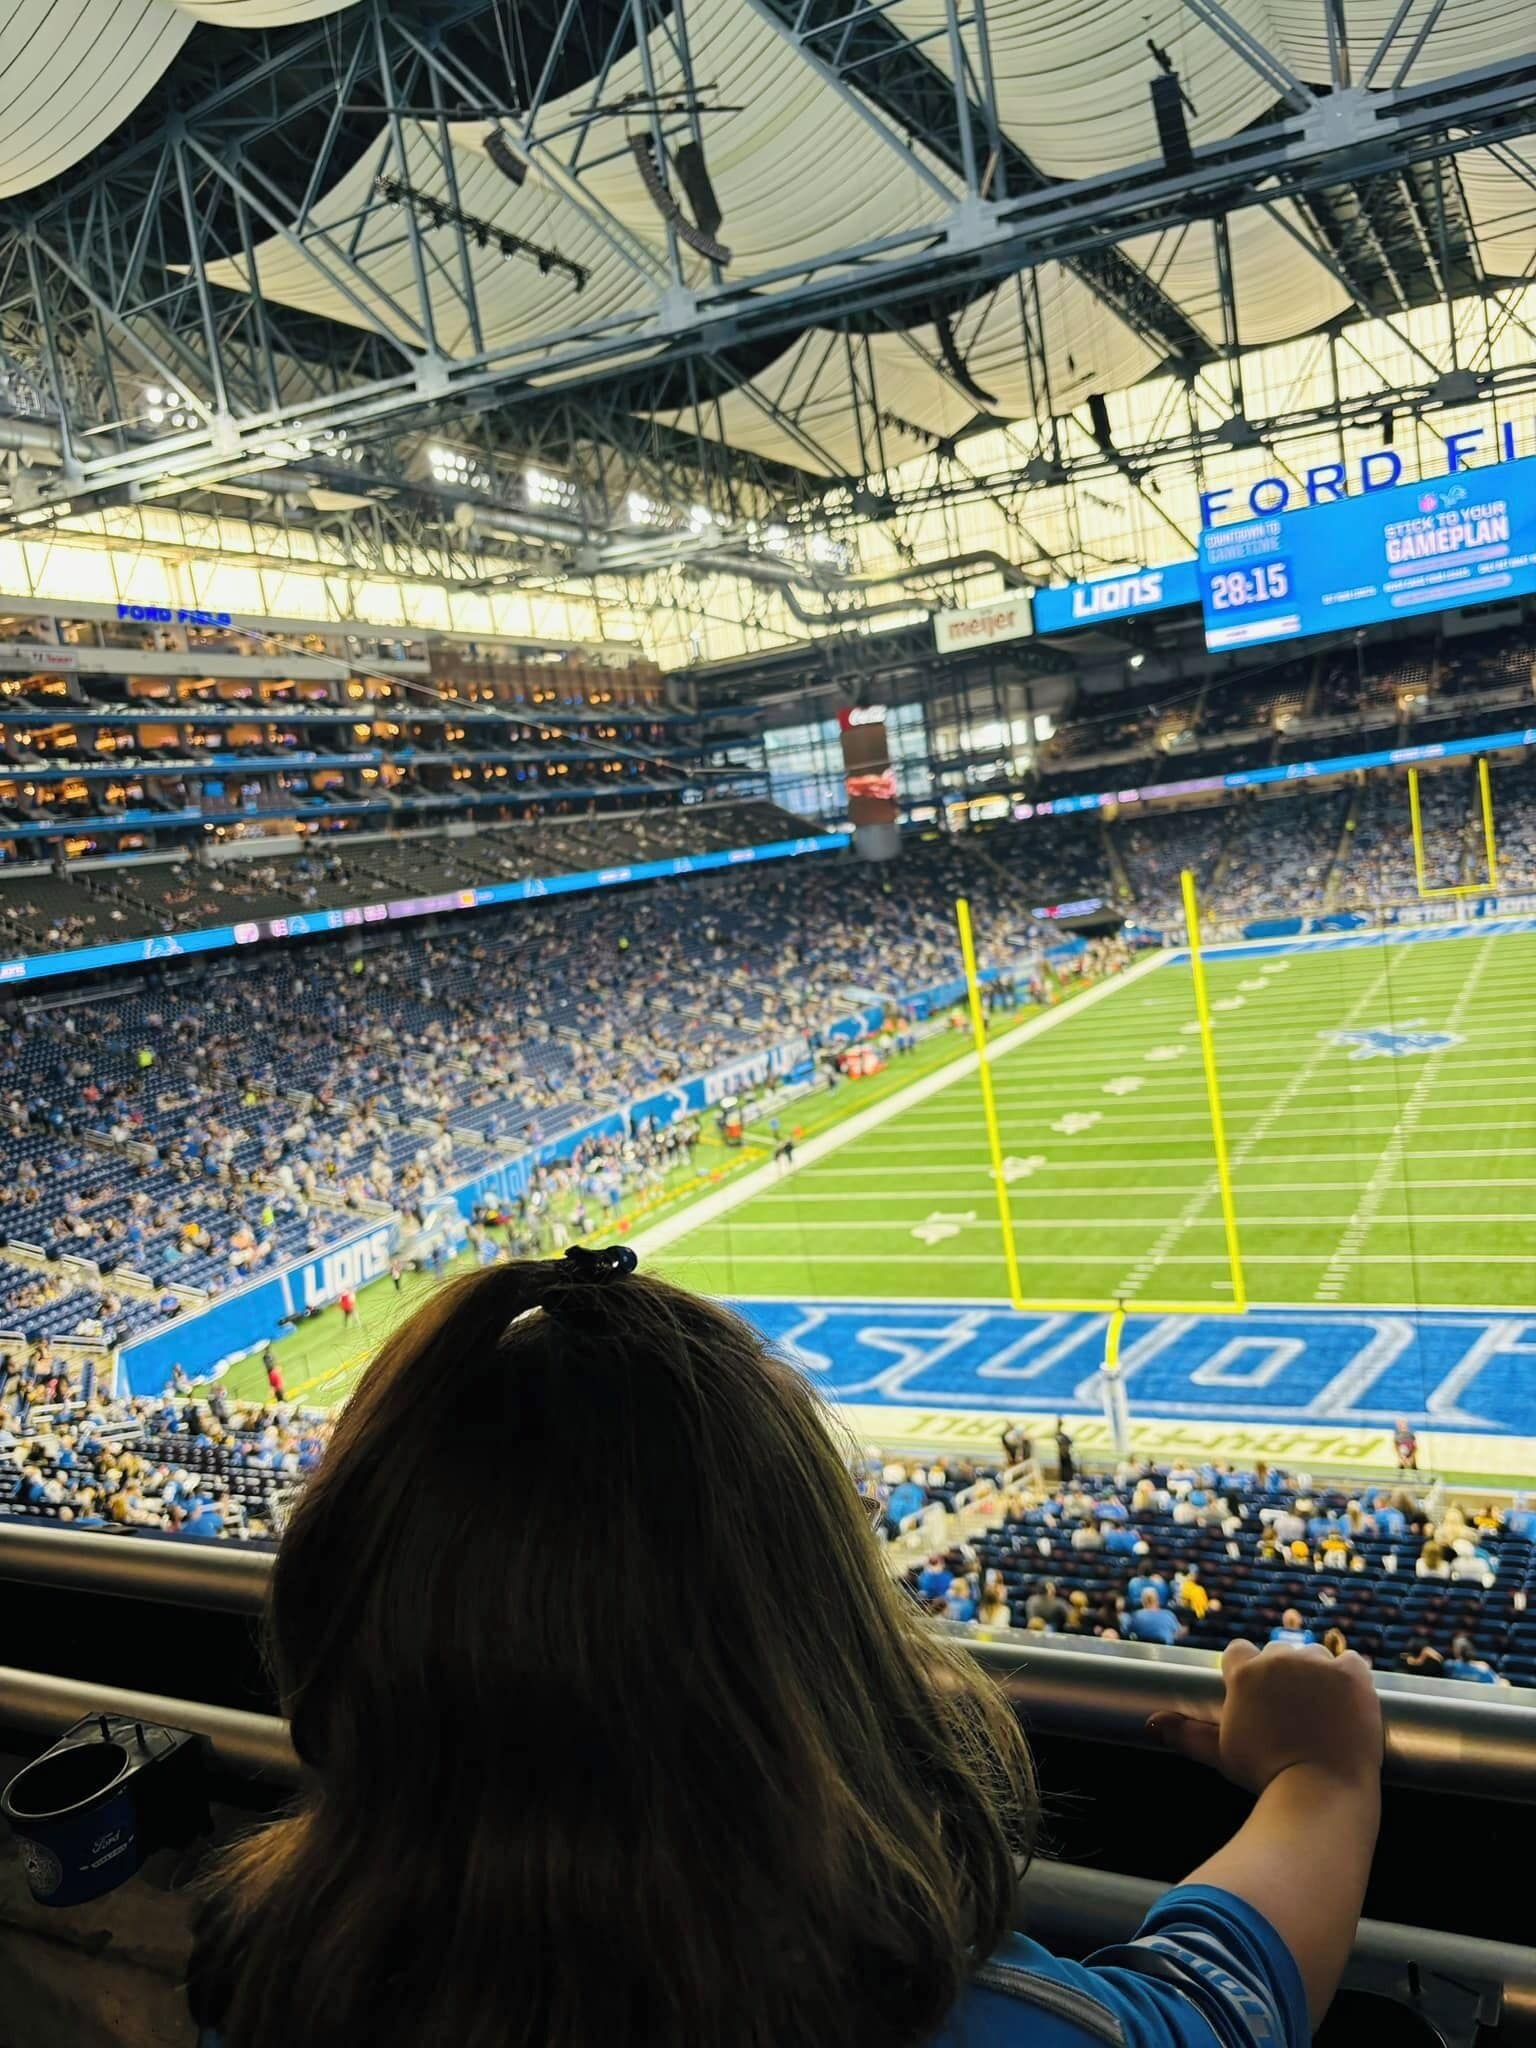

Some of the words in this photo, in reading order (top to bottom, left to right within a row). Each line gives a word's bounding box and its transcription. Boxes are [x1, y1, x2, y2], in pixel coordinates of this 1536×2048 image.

[1200, 449, 1402, 528] FORD
[1445, 420, 1536, 474] FI
[1384, 516, 1434, 540] STICK
[1436, 510, 1459, 527] TO
[1461, 500, 1506, 521] YOUR
[1385, 514, 1509, 564] GAMEPLAN
[1072, 571, 1164, 619] LIONS
[1210, 562, 1288, 610] 28:15
[117, 603, 172, 621] FORD
[178, 608, 232, 626] FIELD
[949, 609, 1015, 640] meijer
[303, 1228, 390, 1307] LIONS
[92, 1829, 121, 1854] Ford
